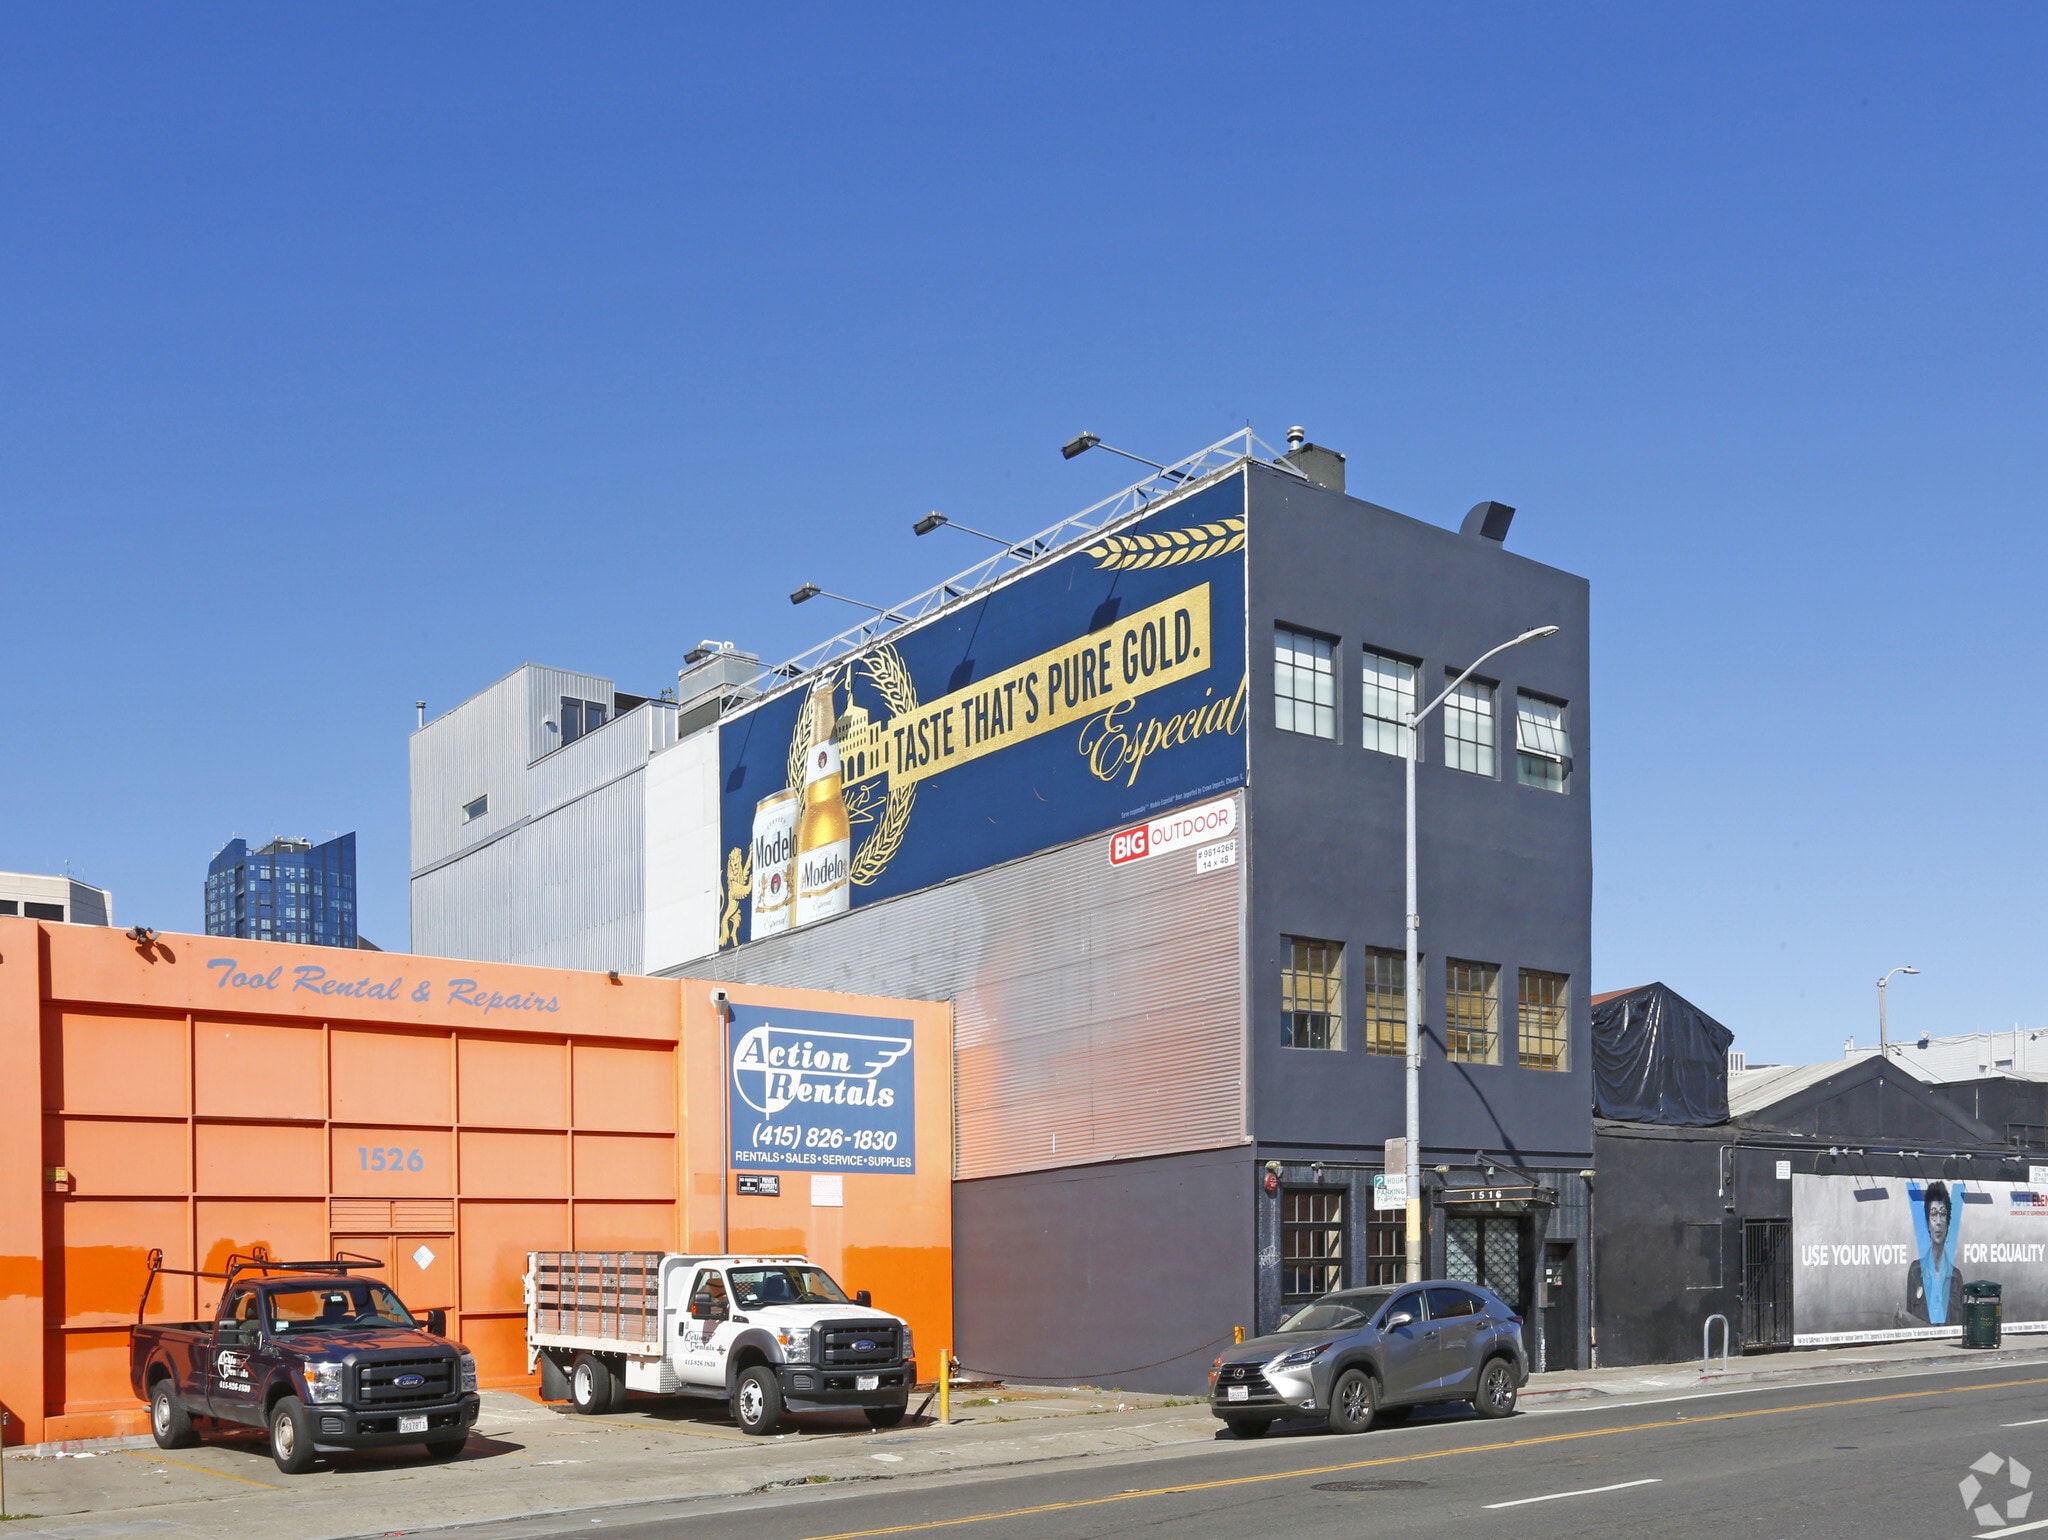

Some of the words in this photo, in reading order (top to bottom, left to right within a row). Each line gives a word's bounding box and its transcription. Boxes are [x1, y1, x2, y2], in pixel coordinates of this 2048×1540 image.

[894, 707, 954, 775] TASTE
[961, 672, 1039, 748] THAT'S
[1048, 639, 1112, 717] PURE
[1122, 608, 1201, 685] GOLD.
[1078, 671, 1247, 788] Especial
[756, 826, 798, 871] Modelo
[1114, 831, 1145, 860] BIG
[1151, 809, 1228, 845] OUTDOOR
[804, 854, 843, 889] Modelo
[207, 957, 283, 990] Tool
[292, 965, 403, 1001] Rental
[411, 980, 431, 1002] &
[447, 978, 561, 1015] Repairs
[740, 1037, 852, 1071] Action
[768, 1073, 894, 1108] Rentals
[752, 1122, 802, 1149] (415)
[805, 1127, 898, 1151] 826-1830
[358, 1147, 424, 1172] 1526
[735, 1150, 780, 1163] RENTALS
[785, 1152, 817, 1164] SALES
[823, 1154, 863, 1166] SERVICE
[868, 1156, 912, 1168] SUPPLIES
[1376, 1188, 1405, 1196] PARKING
[1388, 1177, 1404, 1185] HOUR
[1470, 1190, 1502, 1200] 1516
[1802, 1245, 1828, 1267] USE
[1832, 1244, 1871, 1266] YOUR
[1872, 1244, 1907, 1265] VOTE
[1964, 1243, 1988, 1263] FOR
[1990, 1243, 2046, 1264] EQUALITY
